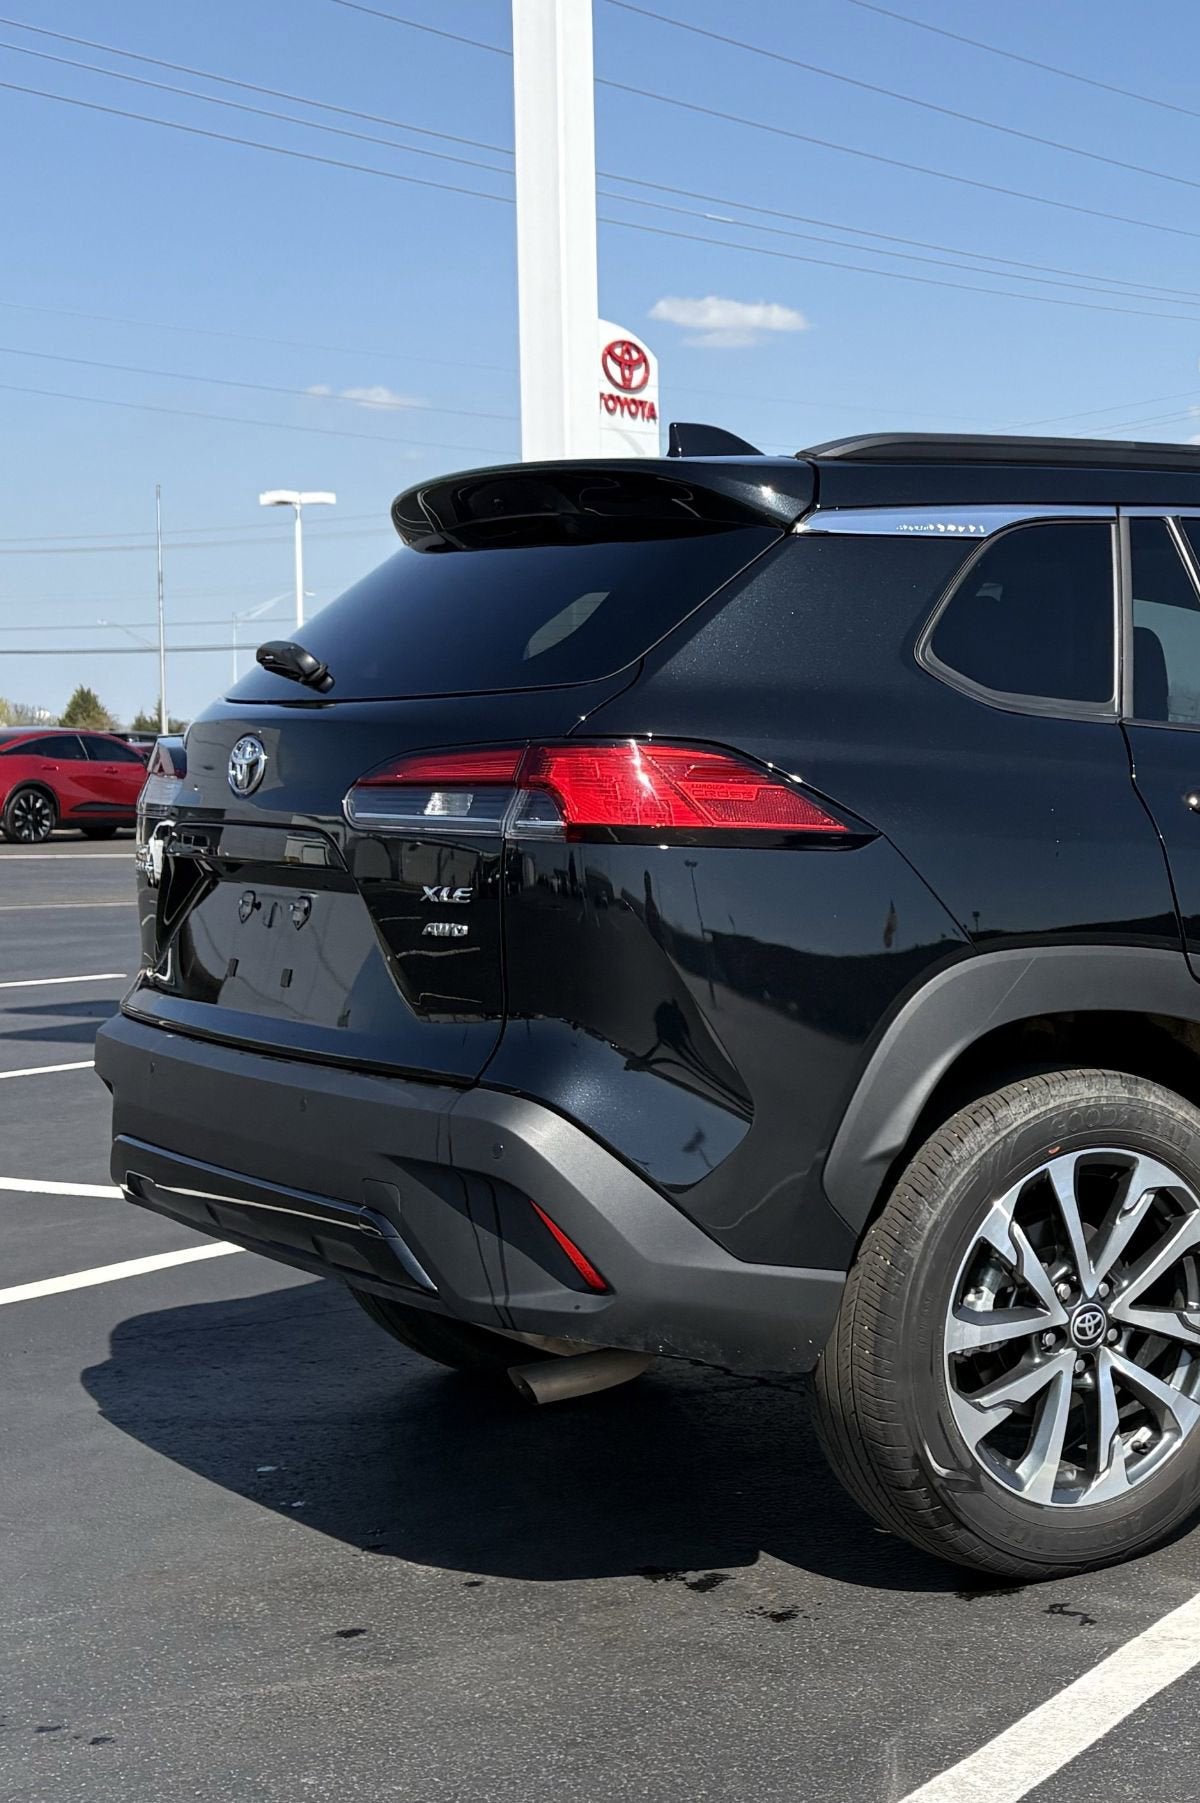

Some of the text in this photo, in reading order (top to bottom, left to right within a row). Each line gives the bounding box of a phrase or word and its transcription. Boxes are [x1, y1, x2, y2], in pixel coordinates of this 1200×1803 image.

[692, 789, 755, 799] CROSS
[420, 885, 473, 903] XLE
[421, 922, 469, 936] AWD
